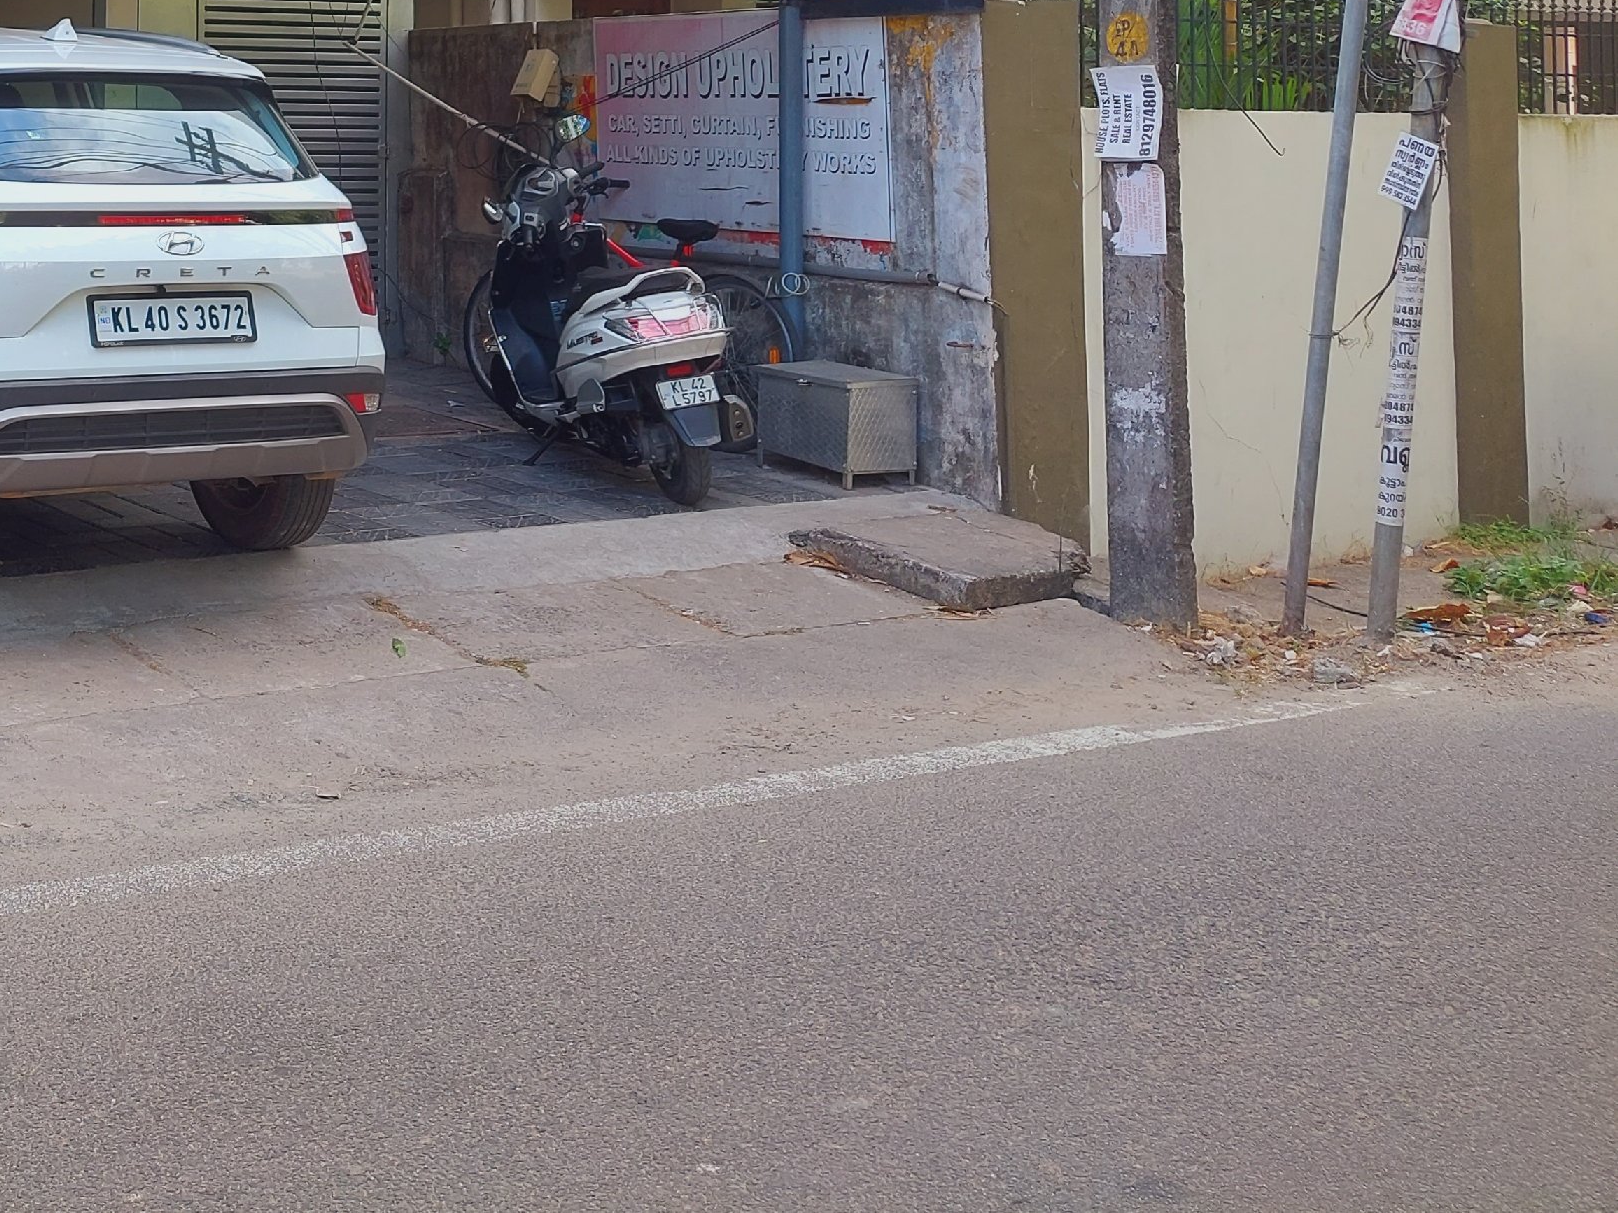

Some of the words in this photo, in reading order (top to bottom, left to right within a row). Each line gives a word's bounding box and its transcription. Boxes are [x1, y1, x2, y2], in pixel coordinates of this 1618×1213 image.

[605, 50, 690, 101] DESIGN
[694, 45, 870, 100] UPHOLTERY
[1096, 72, 1109, 96] FLATS
[1113, 94, 1122, 116] RENT
[1124, 93, 1133, 123] ESTATE
[1139, 74, 1157, 157] 8129748016
[608, 113, 640, 137] CAR,
[643, 114, 687, 139] SETTI,
[691, 115, 762, 140] CURTAIN,
[1110, 124, 1121, 144] SALE
[1122, 127, 1132, 144] REAL
[683, 147, 701, 167] OF
[813, 150, 877, 175] WORKS
[89, 266, 271, 279] CRETA
[111, 306, 140, 333] KL
[144, 305, 170, 332] 40
[176, 304, 189, 331] S
[194, 303, 248, 332] 3672
[671, 380, 689, 394] KL
[691, 377, 707, 390] 42
[672, 394, 682, 407] L
[682, 389, 713, 405] 5797
